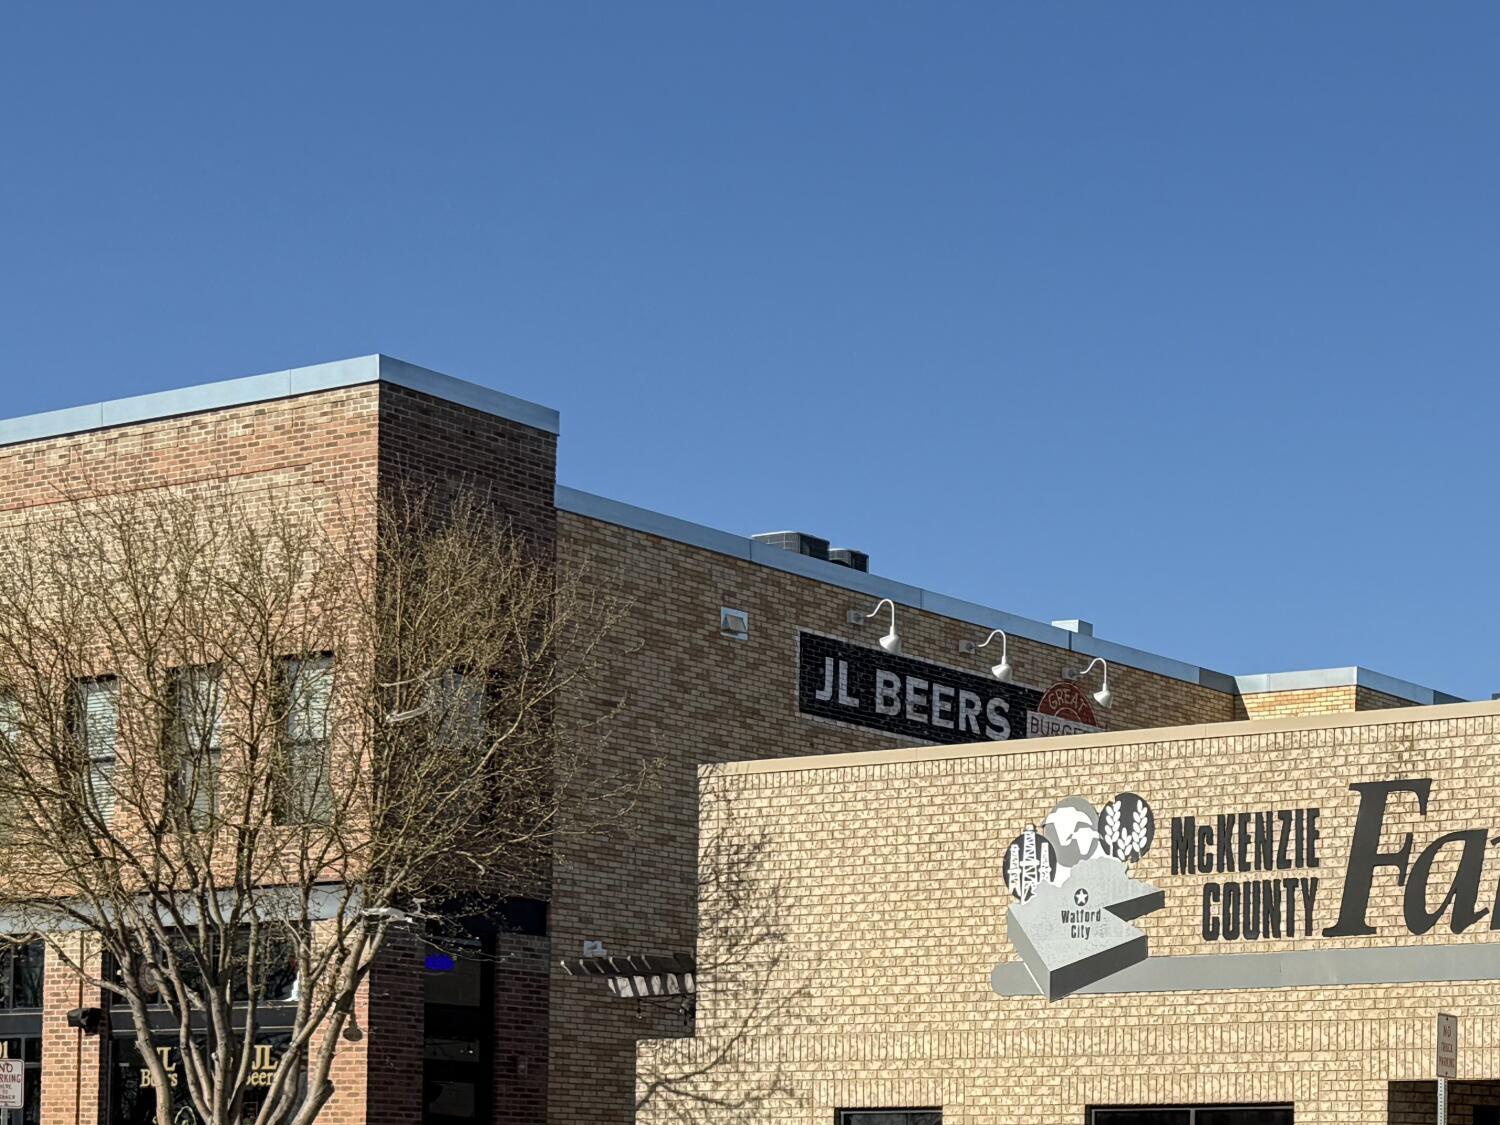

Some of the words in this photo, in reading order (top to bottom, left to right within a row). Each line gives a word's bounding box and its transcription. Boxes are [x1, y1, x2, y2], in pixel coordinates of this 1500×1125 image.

[816, 657, 860, 708] JL
[875, 669, 1012, 741] BEERS
[1048, 688, 1087, 711] GREAT
[1030, 716, 1085, 737] BURG
[1061, 907, 1102, 924] Watford
[1202, 877, 1319, 941] COUNTY
[1070, 924, 1091, 941] City
[0, 1041, 8, 1059] 1
[157, 1047, 177, 1071] L
[252, 1045, 278, 1069] JL
[0, 1063, 13, 1073] NO
[0, 1074, 22, 1083] RKING
